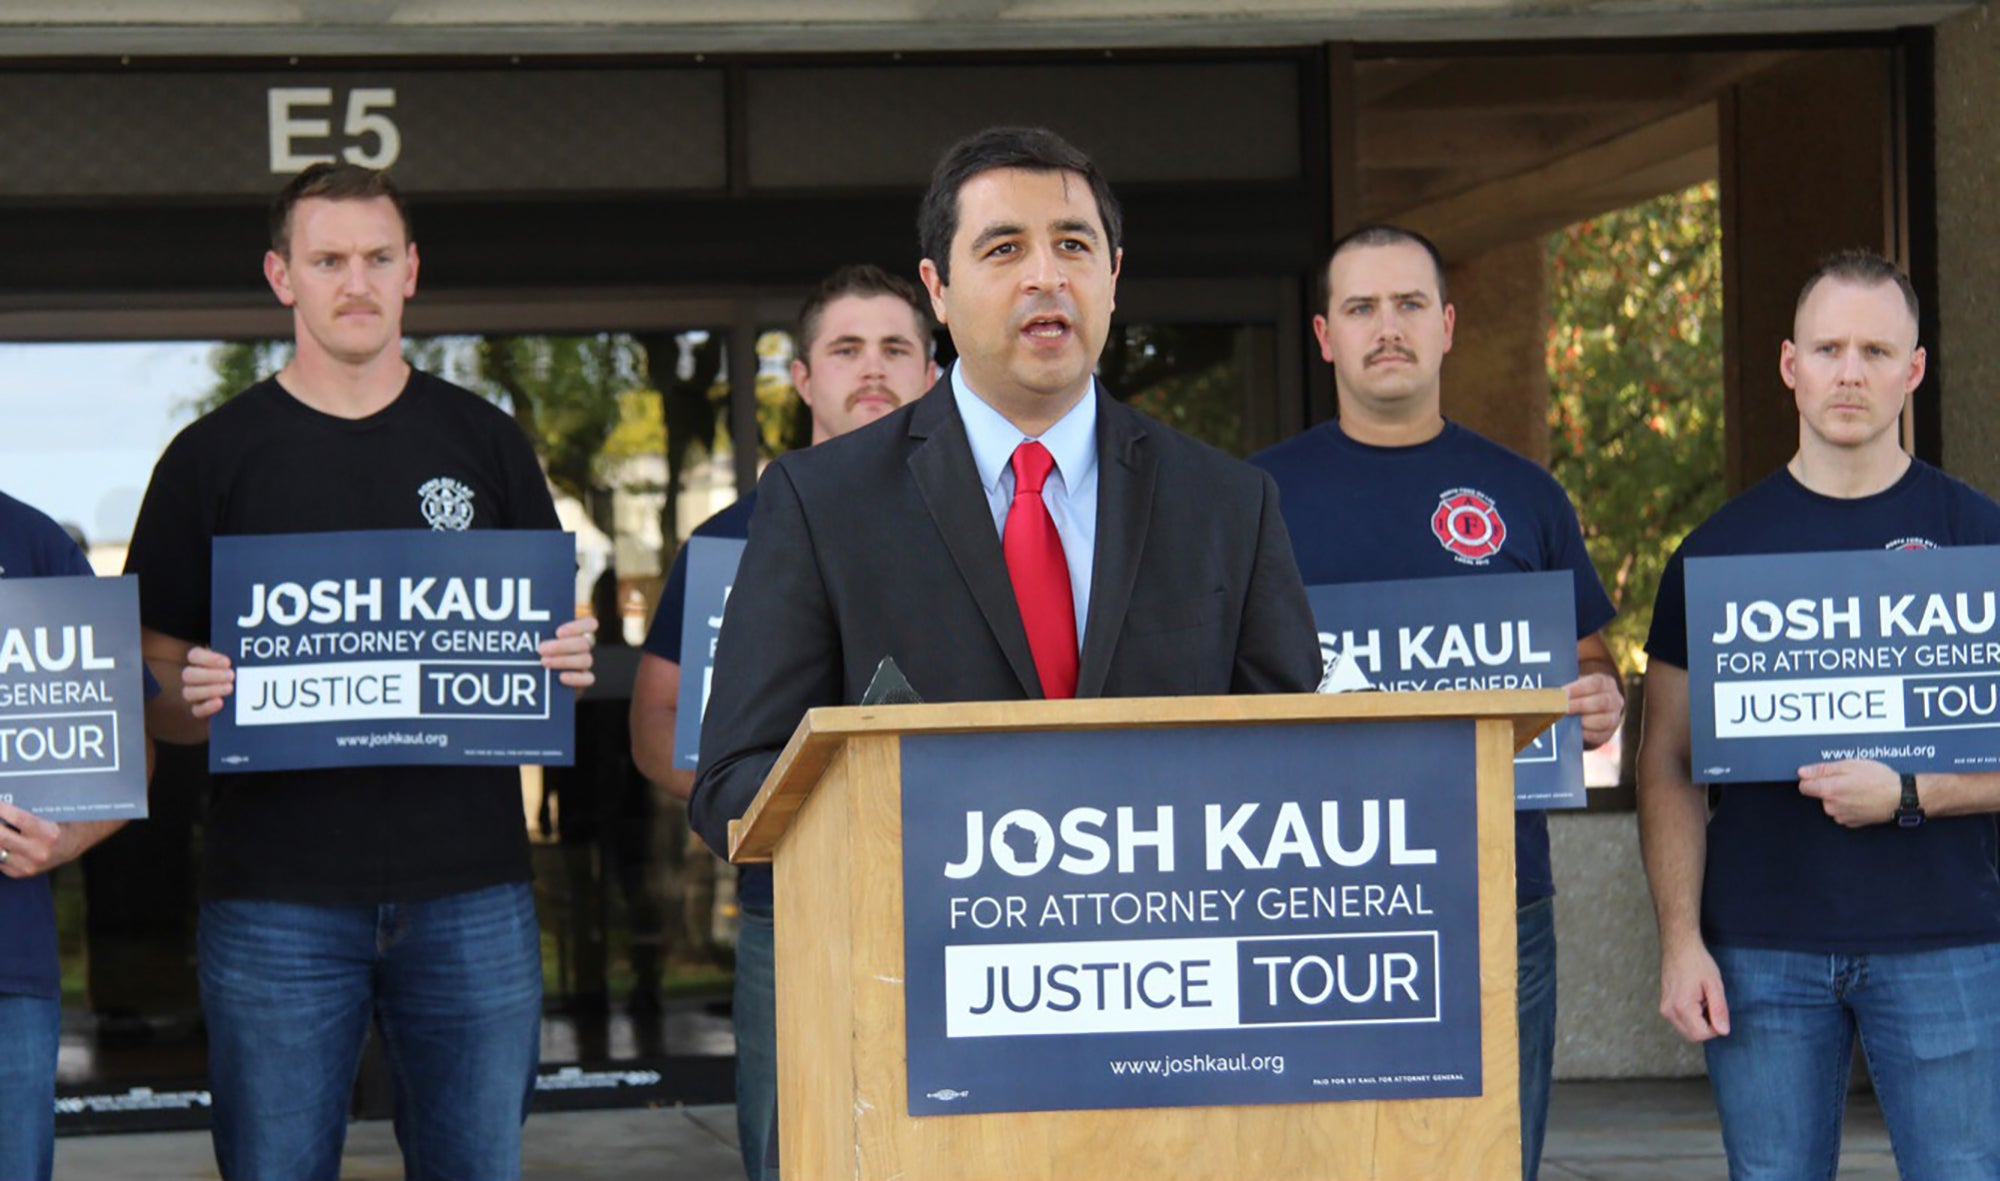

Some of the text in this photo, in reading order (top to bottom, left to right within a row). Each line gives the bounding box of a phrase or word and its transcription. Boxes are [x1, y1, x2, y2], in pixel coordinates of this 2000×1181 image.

[269, 89, 400, 173] E5
[238, 578, 550, 627] JOSH KAUL
[1713, 592, 1995, 643] JOSH KAU
[0, 626, 114, 672] AUL
[241, 630, 541, 658] FOR ATTORNEY GENERAL
[1317, 621, 1551, 672] SH KAUL
[1717, 643, 2000, 673] FOR ATTORNEY GENER
[0, 681, 113, 706] GENERAL
[252, 673, 536, 710] JUSTICE TOUR
[1731, 684, 1996, 723] JUSTICE TOU
[0, 725, 104, 762] TOUR
[337, 732, 448, 747] www.joshkaul.org
[1821, 745, 1935, 759] www.joshkaul.org
[944, 799, 1436, 879] JOSH KAUL
[951, 884, 1433, 928] FOR ATTORNEY GENERAL
[970, 953, 1419, 1014] JUSTICE TOUR
[1110, 1053, 1284, 1076] www.joshkaul.org
